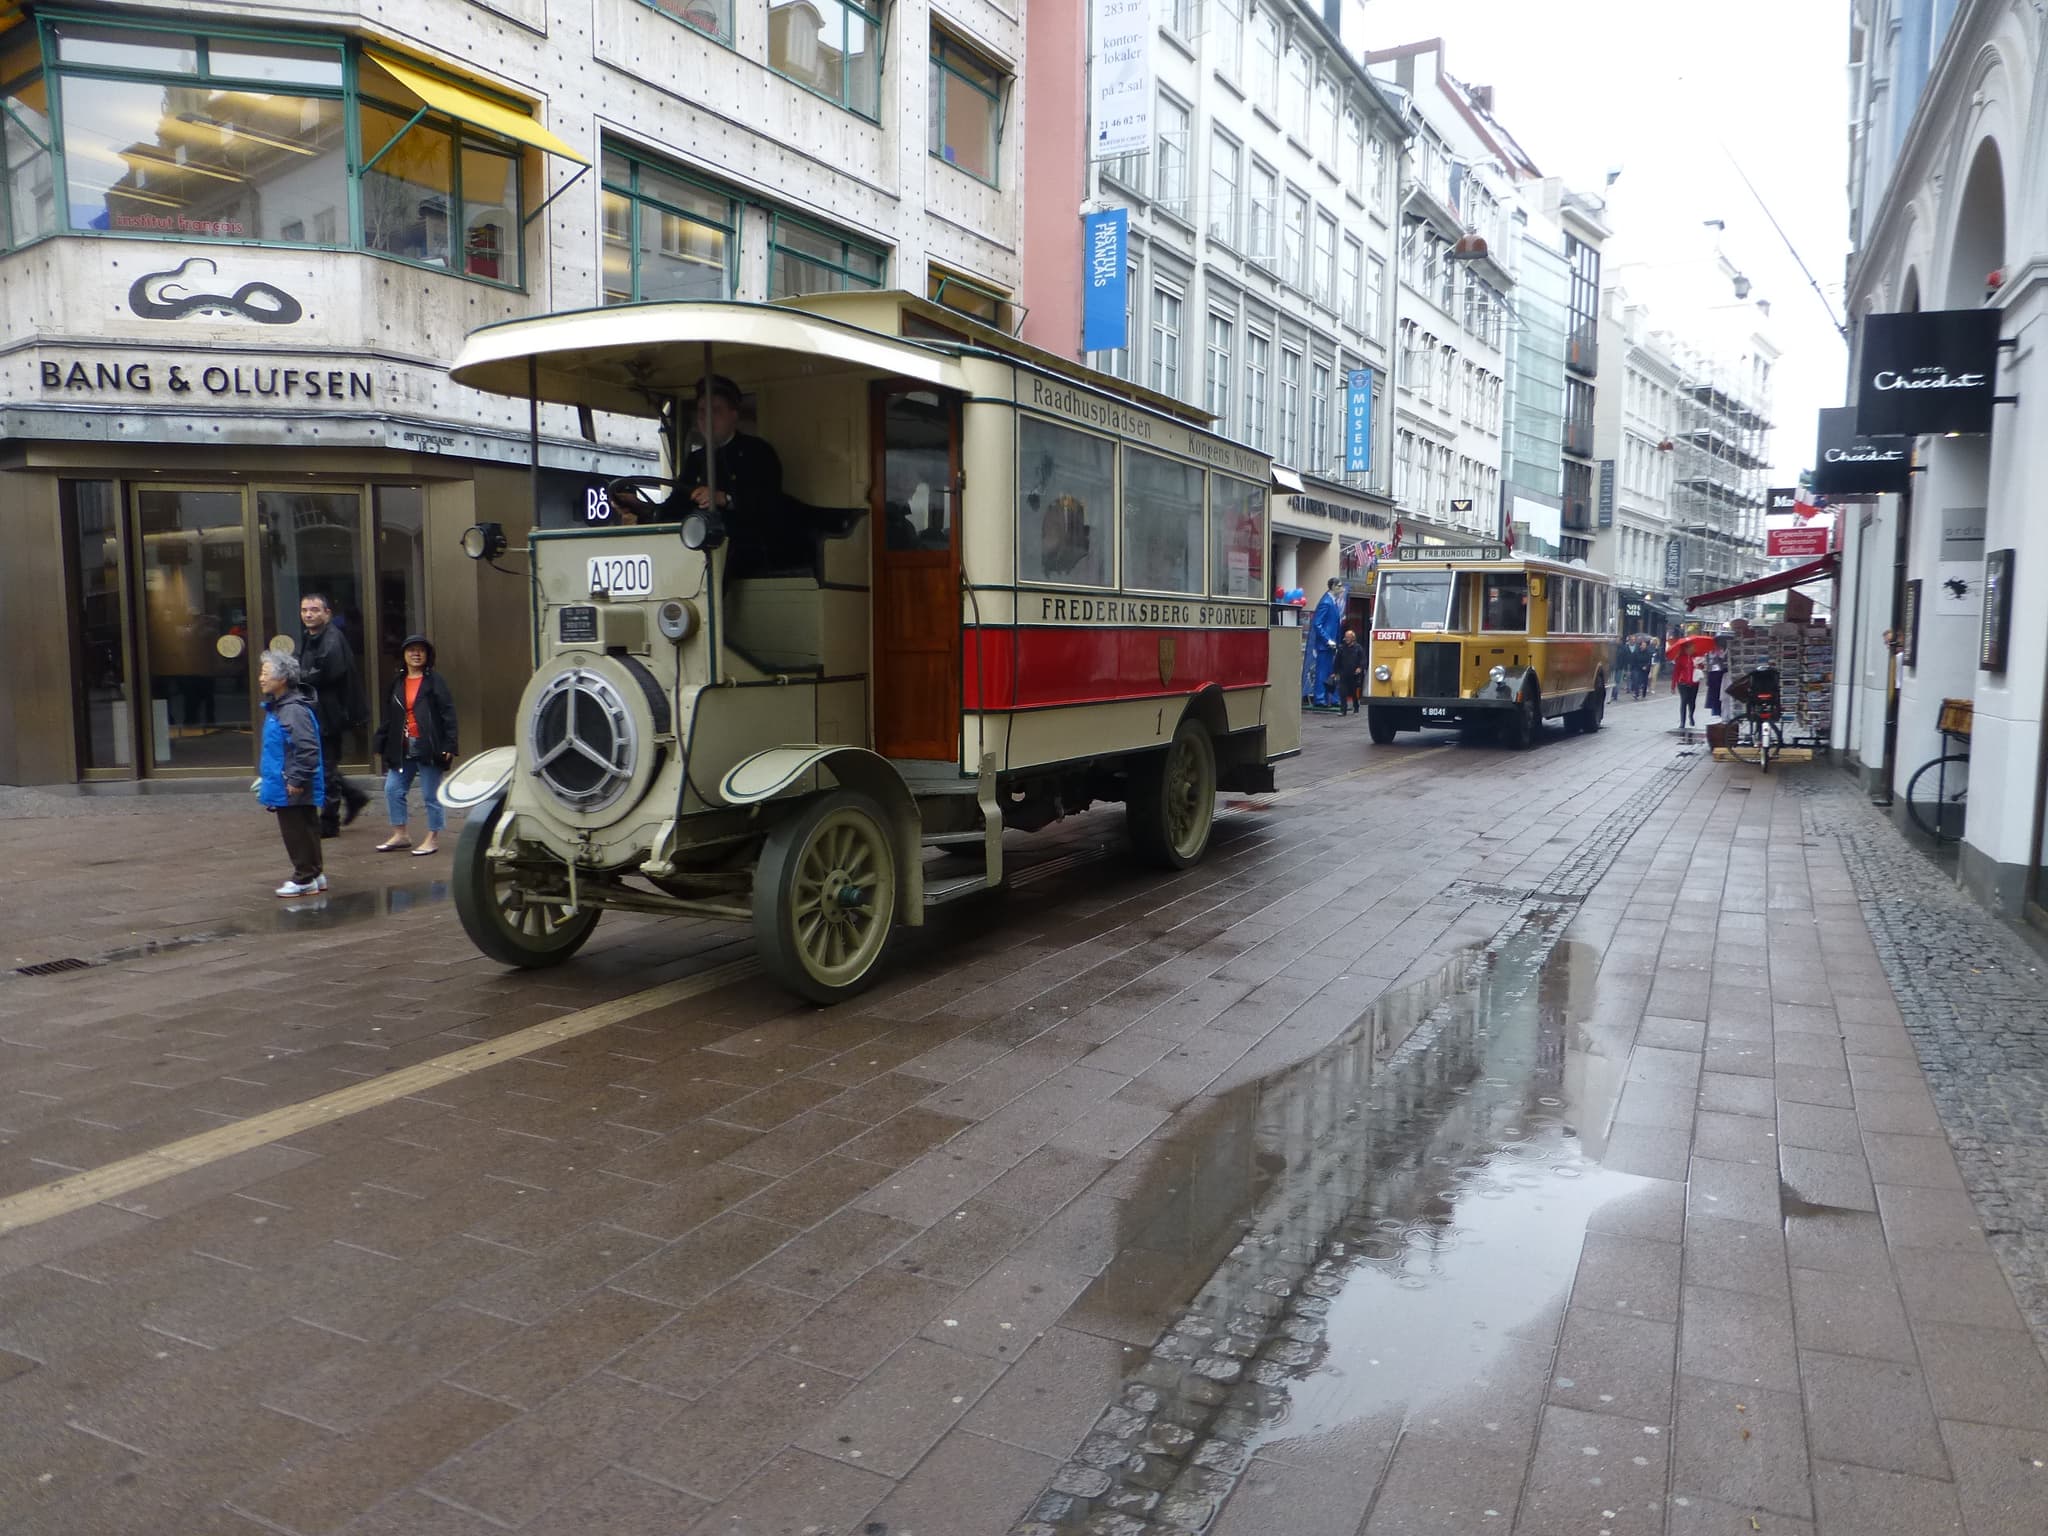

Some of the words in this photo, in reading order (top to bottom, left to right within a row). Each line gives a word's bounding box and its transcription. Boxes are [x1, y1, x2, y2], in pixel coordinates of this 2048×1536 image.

[1104, 48, 1142, 65] lokaler
[1093, 223, 1107, 287] FRANÇAIS
[1105, 221, 1117, 278] INSTITUT
[40, 361, 151, 391] BANG
[168, 365, 191, 392] &
[202, 366, 373, 398] OLUFSEN
[1033, 378, 1151, 440] Raadhuspladsen
[1188, 432, 1230, 465] Kongens
[1351, 393, 1366, 470] MUSEUM
[1486, 549, 1497, 559] 28
[591, 559, 650, 593] A1200
[1042, 598, 1190, 624] FREDERIKSBERG
[1199, 606, 1257, 625] SPORVEIE
[1377, 631, 1406, 640] EKSTRA
